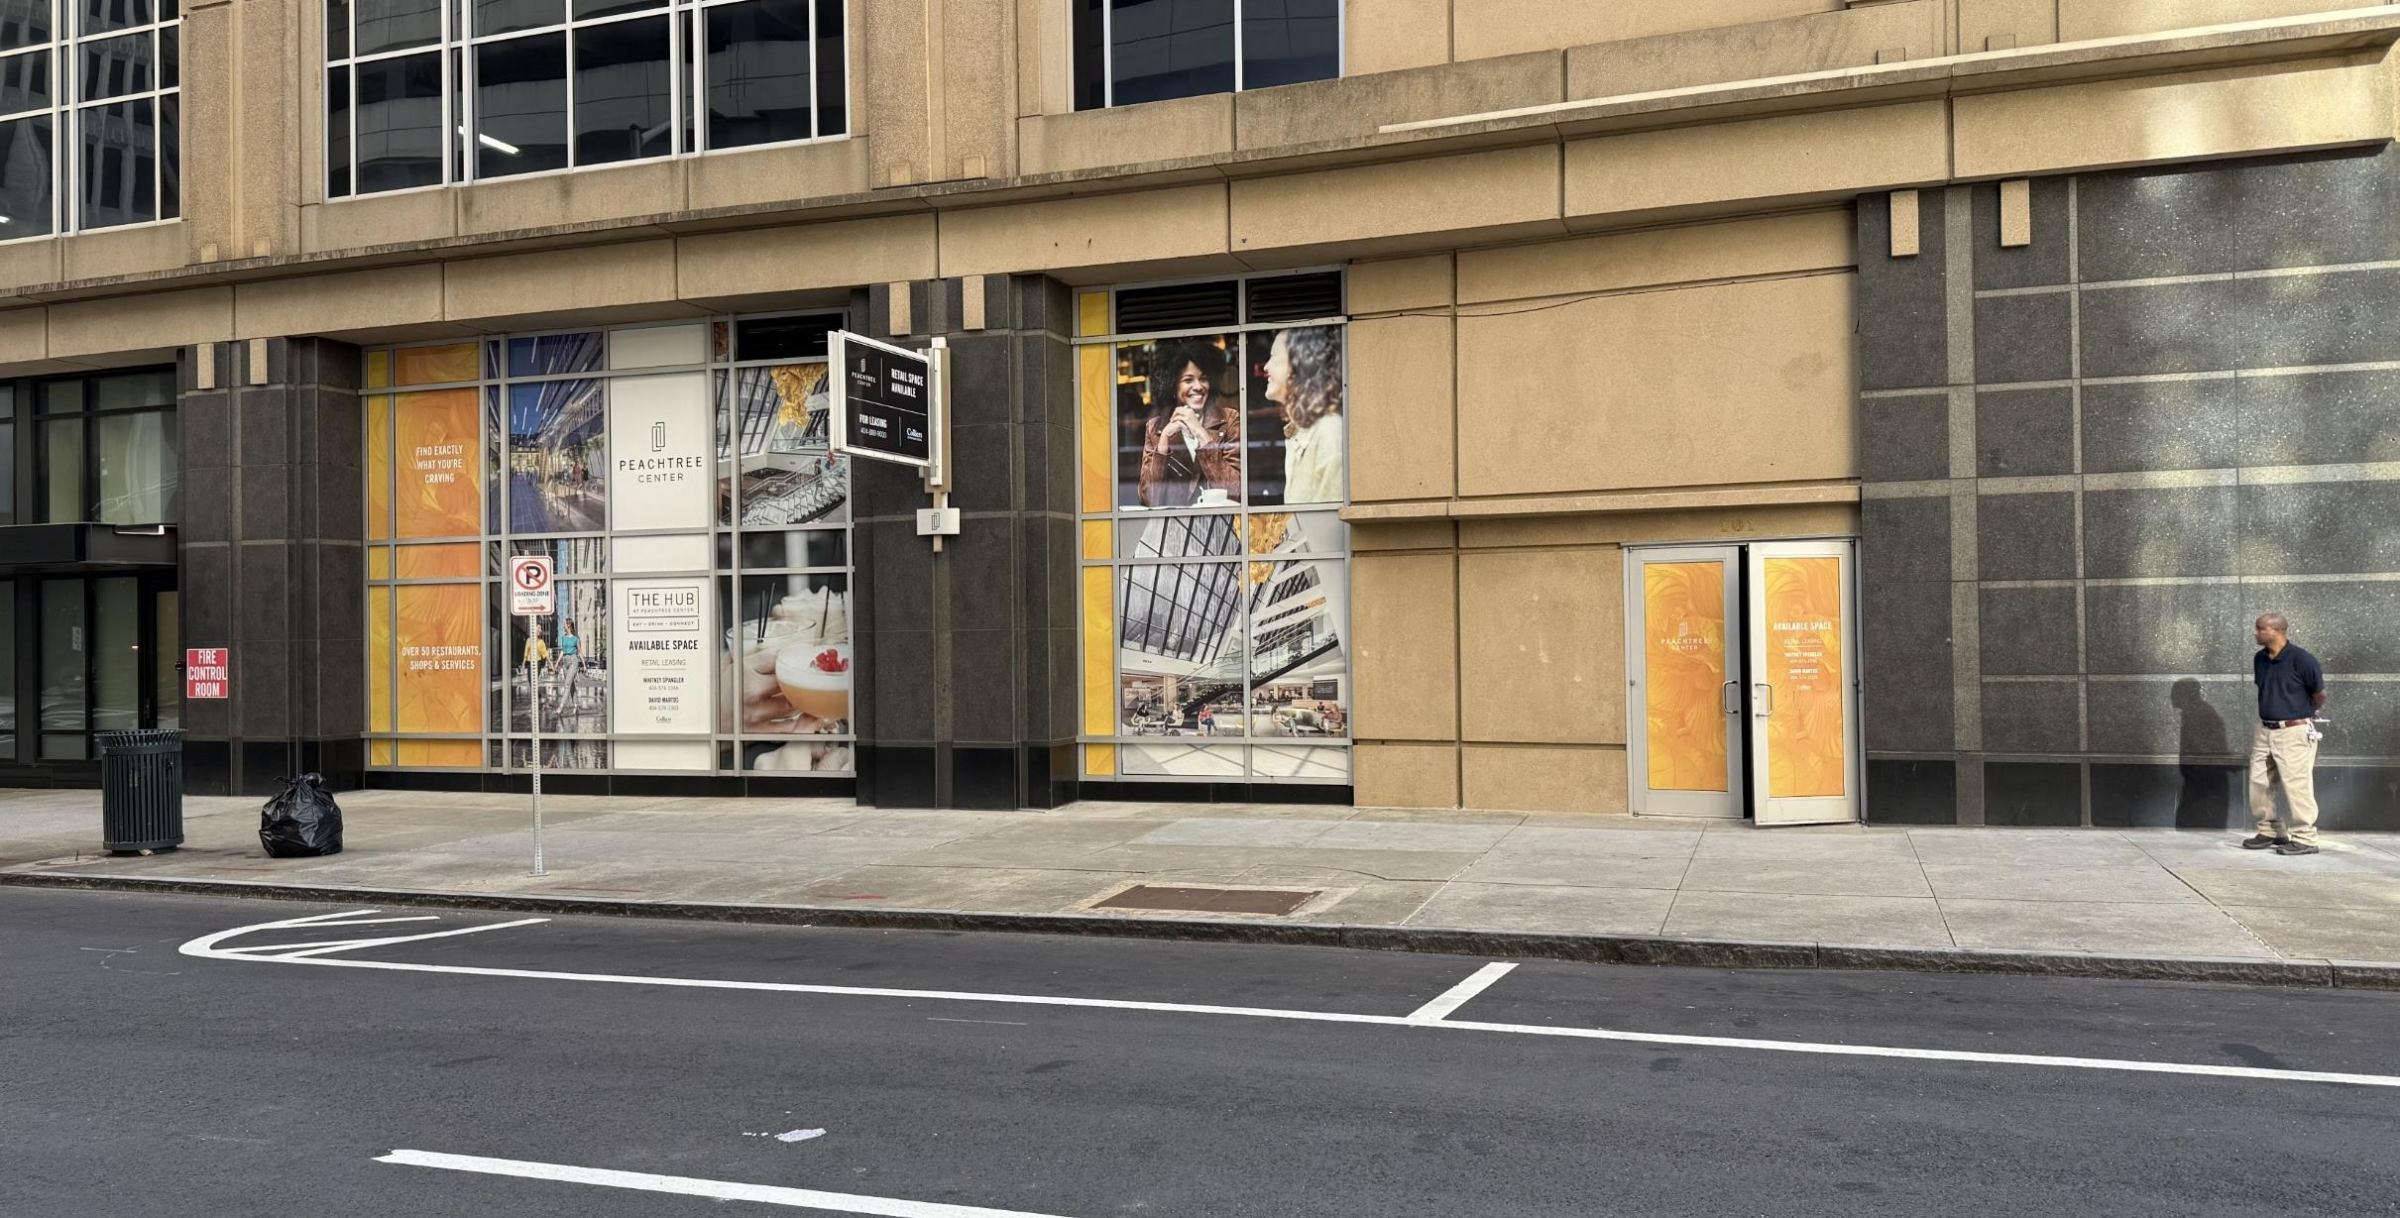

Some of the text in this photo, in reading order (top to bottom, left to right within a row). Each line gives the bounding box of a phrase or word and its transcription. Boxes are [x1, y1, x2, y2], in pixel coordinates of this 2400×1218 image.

[891, 368, 924, 387] RETAIL SPACE
[859, 413, 888, 429] FOR LEASING
[416, 444, 463, 457] FIND EXACTLY
[416, 458, 463, 470] WHAT YOU'RE
[619, 456, 703, 471] PEACHTREE
[424, 472, 455, 484] CRAVING
[638, 473, 684, 483] CENTER
[632, 592, 695, 606] THE HUB
[1773, 621, 1832, 631] AVAILABLE SPACE
[401, 645, 482, 657] OVER 50 RESTAURANTS,
[629, 639, 699, 651] AVAILABLE SPACE
[198, 650, 217, 665] FIRE
[662, 658, 687, 666] LEASING
[410, 660, 476, 671] SHOPS & SERVICES
[189, 666, 228, 681] CONTROL
[195, 682, 220, 697] ROOM
